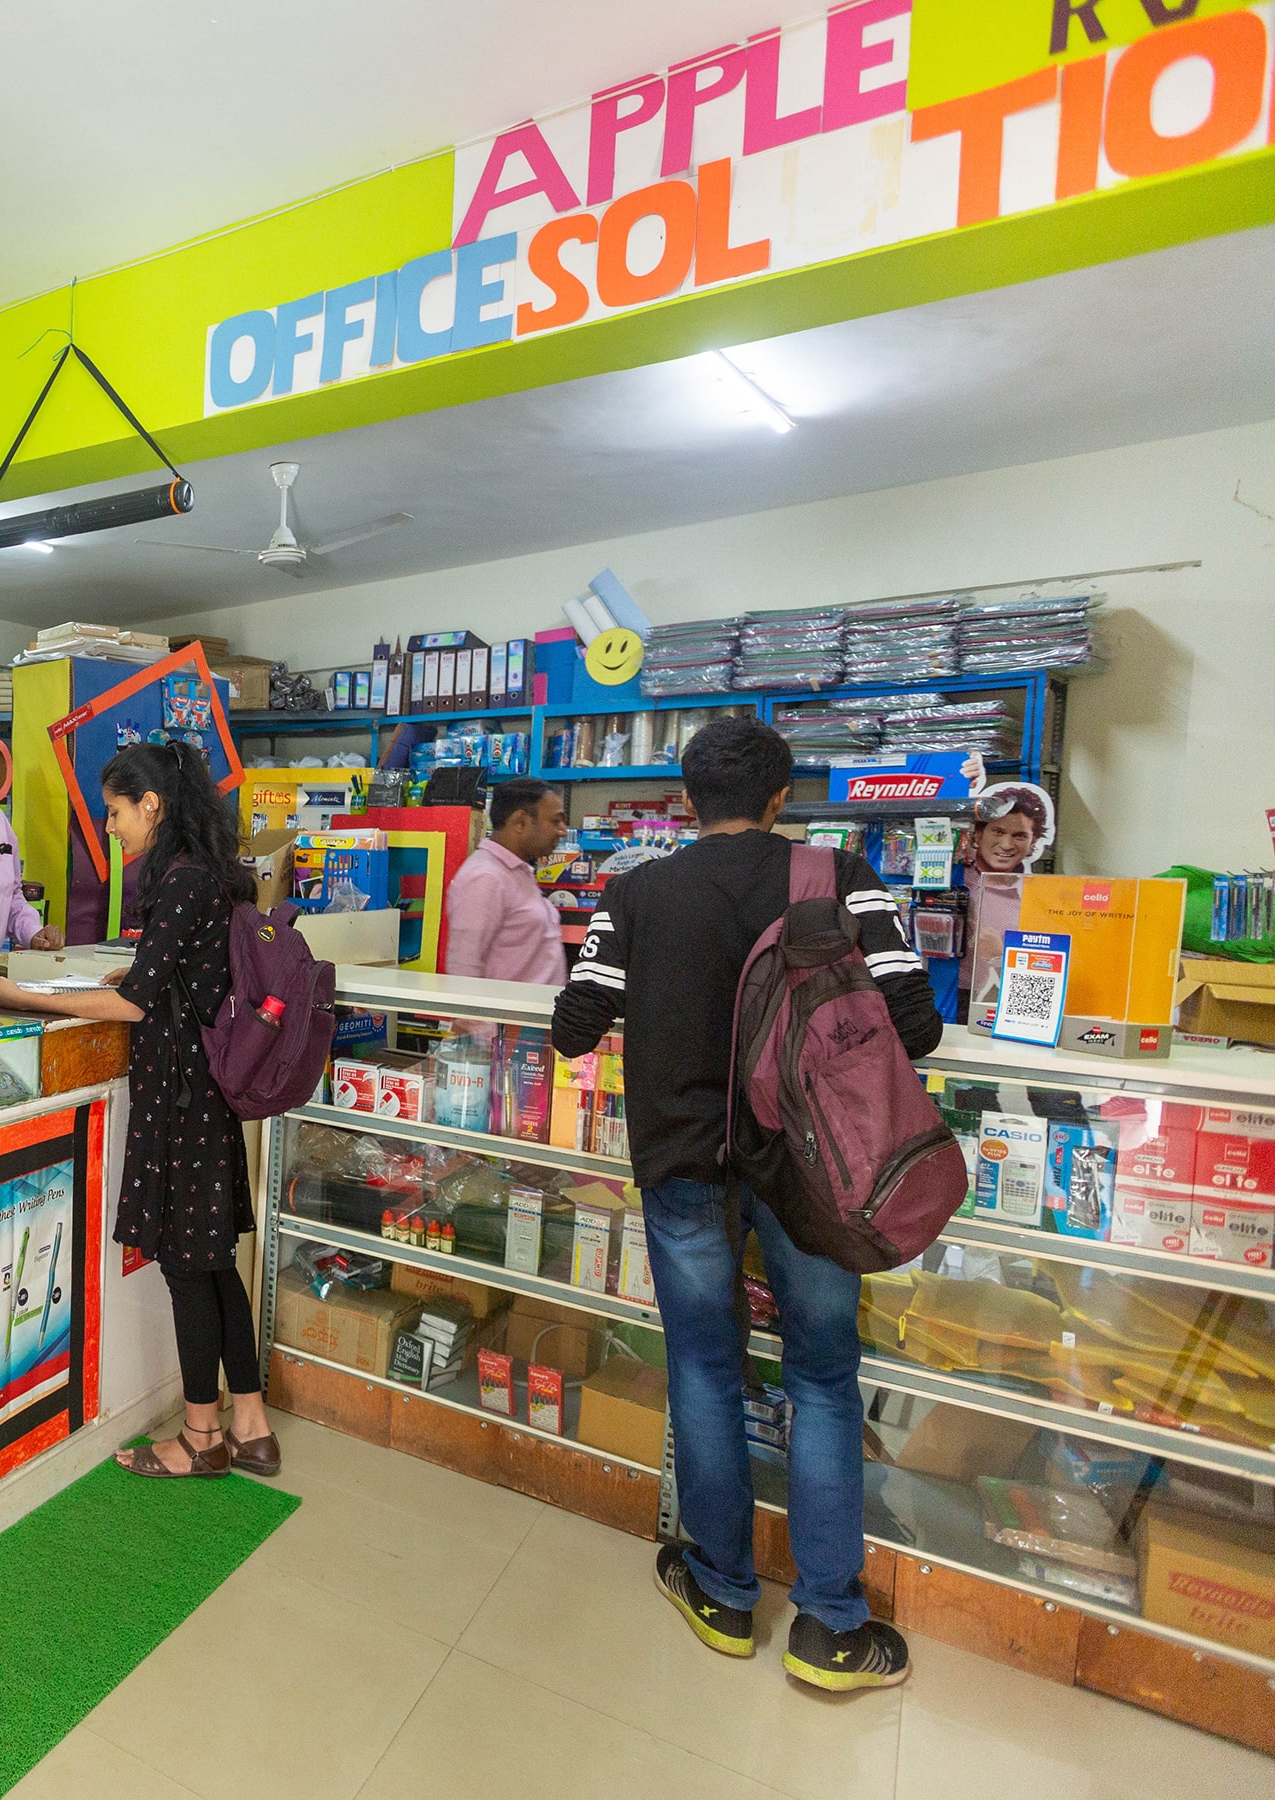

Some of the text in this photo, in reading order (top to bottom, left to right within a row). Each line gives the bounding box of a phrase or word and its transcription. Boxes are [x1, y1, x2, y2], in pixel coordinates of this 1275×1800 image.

[452, 0, 912, 250] APPLE
[209, 232, 518, 410] OFFICE
[850, 778, 939, 800] Reynolds
[548, 853, 567, 864] SAVE
[919, 866, 945, 879] XO
[1083, 893, 1109, 903] cello
[1140, 1035, 1158, 1044] cello
[450, 1073, 484, 1088] DVD-R
[984, 1127, 1043, 1143] CASIO
[18, 1195, 47, 1214] Writing
[47, 1187, 65, 1204] Pens
[1148, 1210, 1186, 1224] elite
[1228, 1222, 1269, 1236] elite
[415, 1277, 444, 1293] brite
[397, 1335, 421, 1352] Oxford
[395, 1352, 408, 1363] Mini
[396, 1343, 421, 1362] English
[393, 1358, 420, 1376] Dictionary
